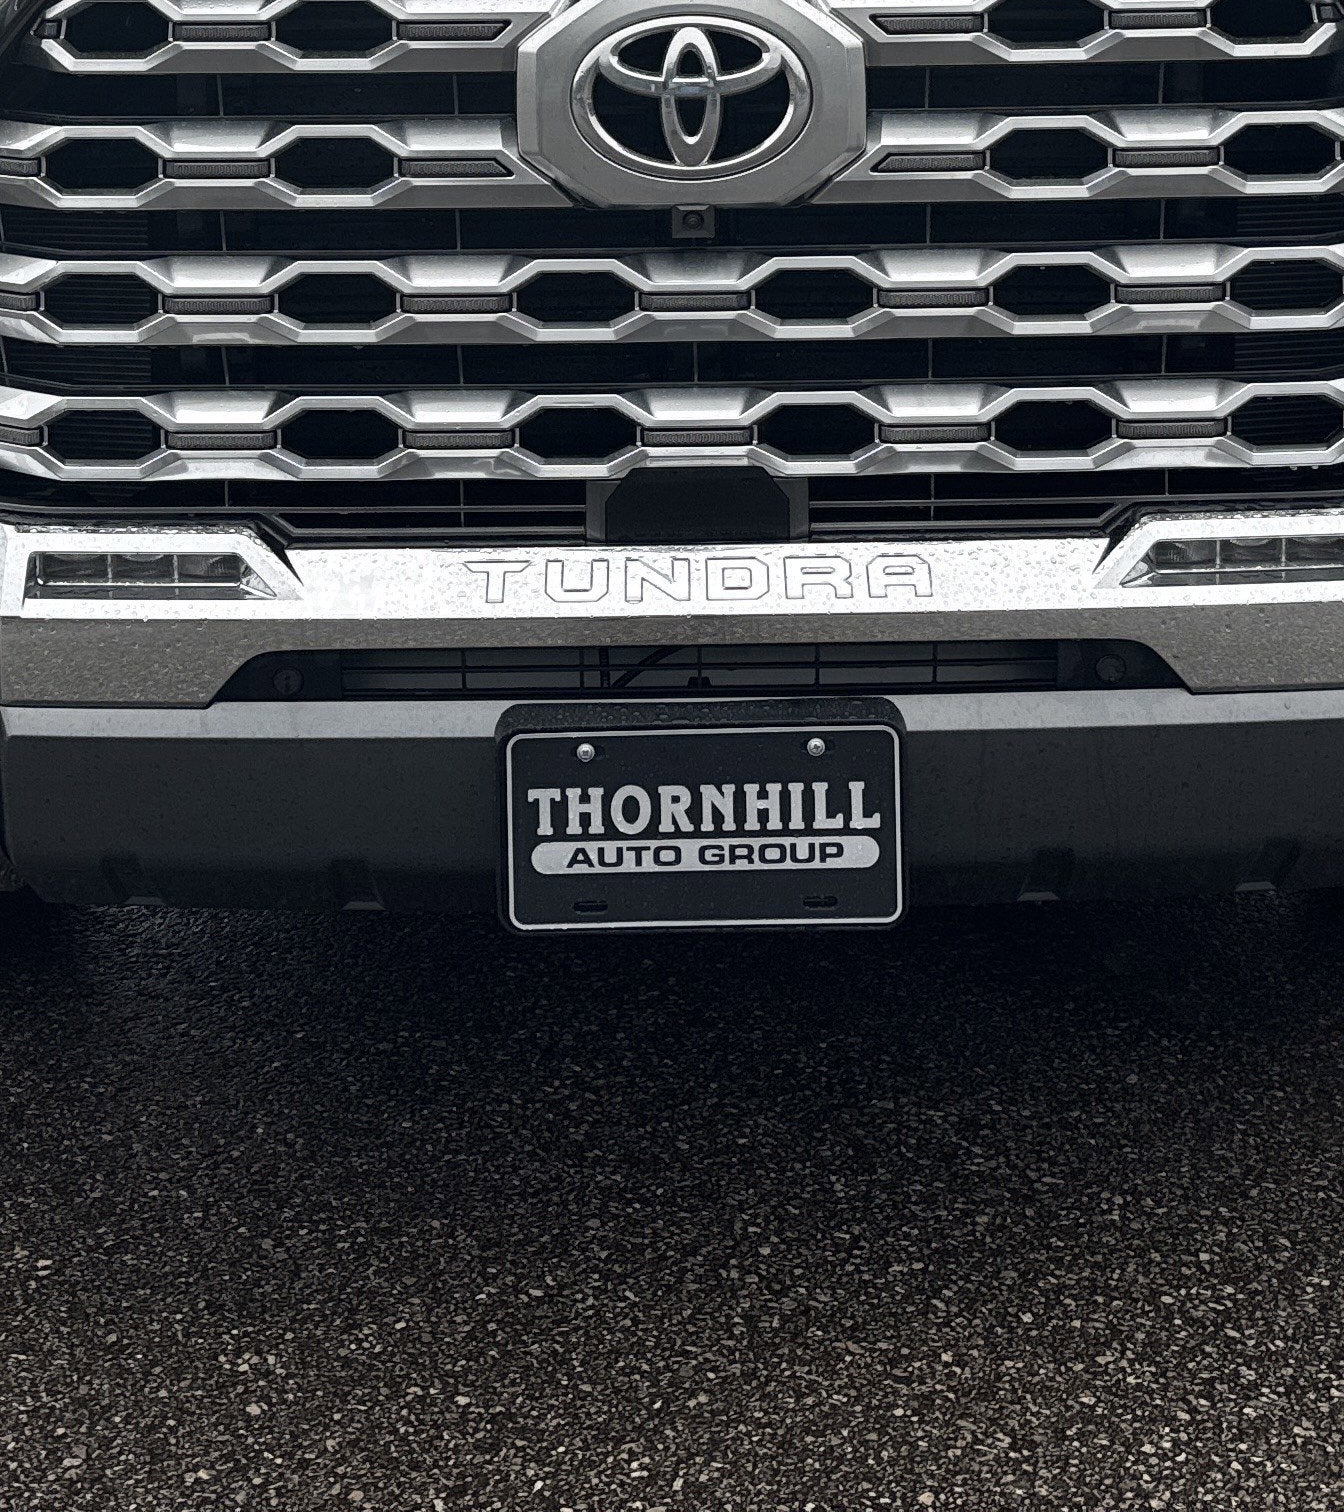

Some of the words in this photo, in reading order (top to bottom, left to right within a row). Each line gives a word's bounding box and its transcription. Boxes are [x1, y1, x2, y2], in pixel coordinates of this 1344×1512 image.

[462, 554, 934, 603] TUNDRA
[527, 781, 882, 836] THORNHILL
[566, 845, 683, 869] AUTO
[697, 842, 845, 867] GROUP
